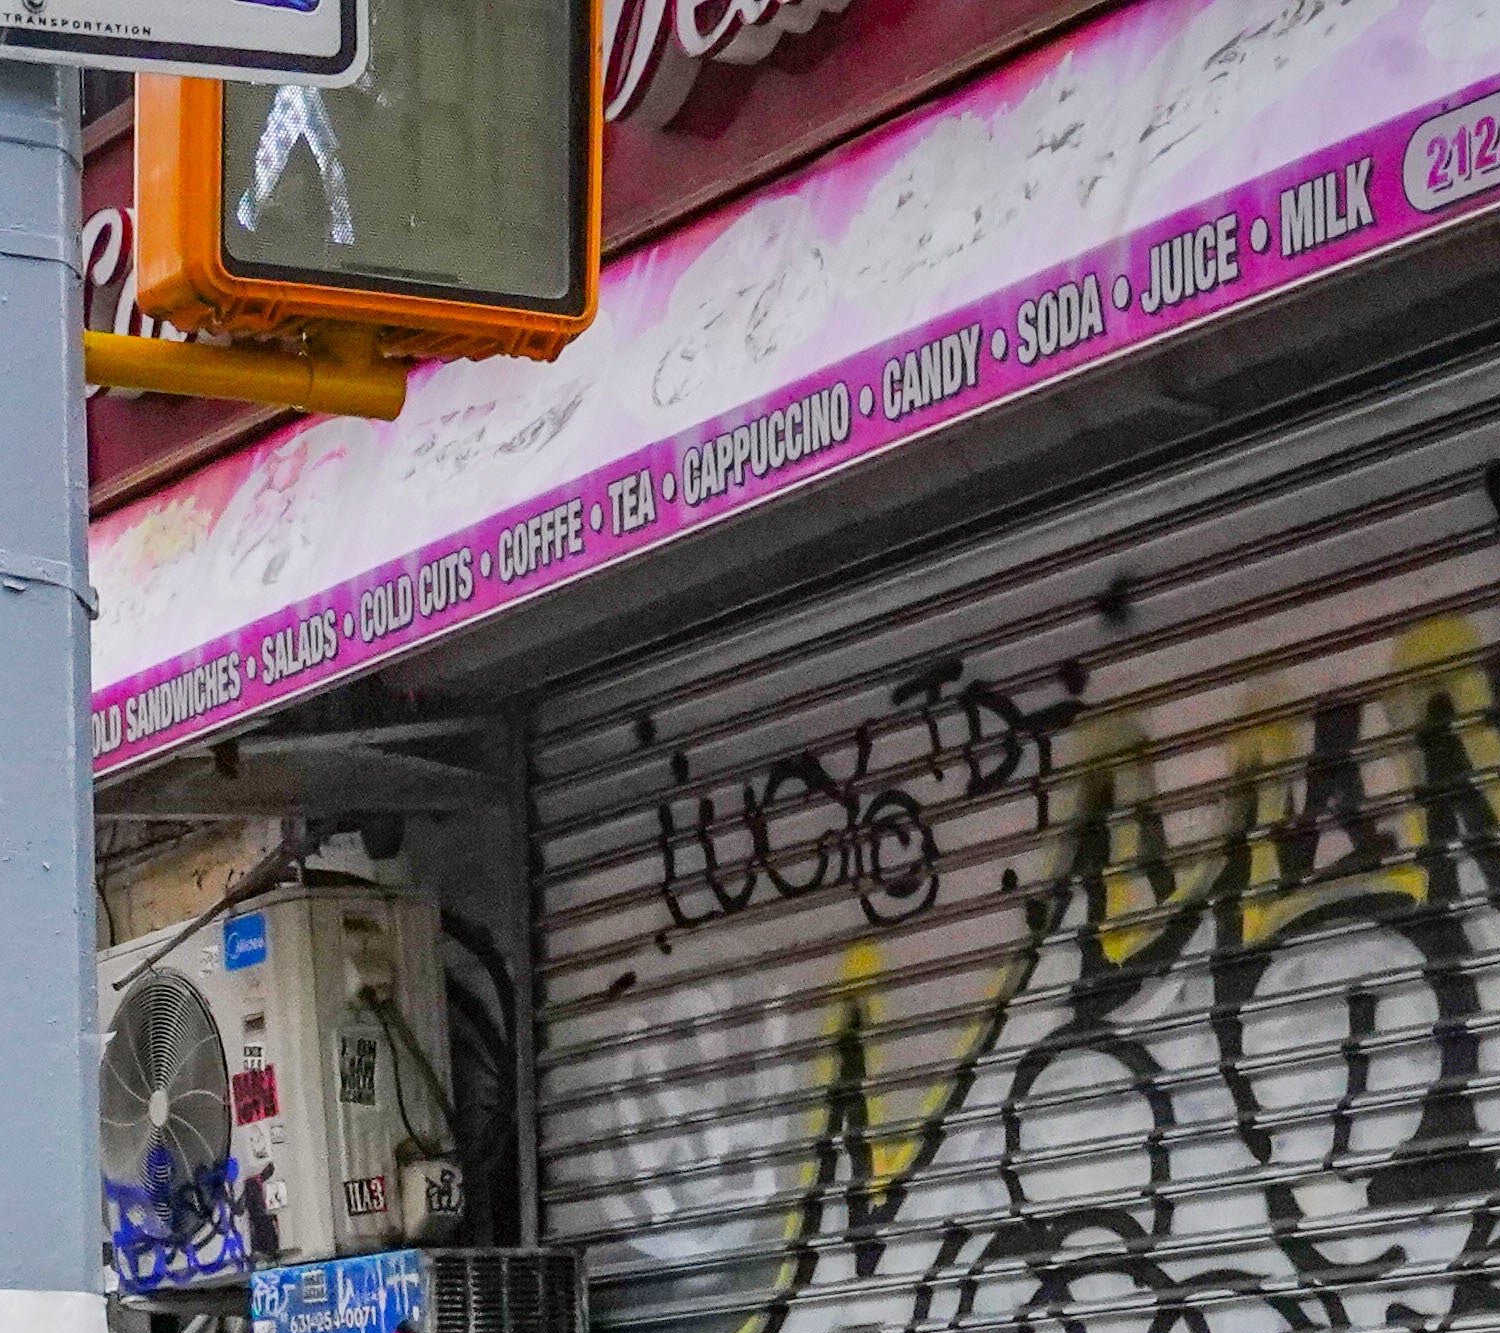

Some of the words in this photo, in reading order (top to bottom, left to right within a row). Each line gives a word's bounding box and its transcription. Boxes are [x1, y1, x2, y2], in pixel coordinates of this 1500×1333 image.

[3, 12, 153, 38] TRANSPORTATION
[90, 702, 122, 755] OLD
[126, 651, 241, 742] SANDWICHES
[261, 608, 339, 685] SALADS
[359, 582, 413, 643] COLD
[418, 547, 475, 618] CUTS
[607, 470, 656, 534] TEA
[682, 381, 851, 506] CAPPUCCINO
[881, 322, 982, 421] CANDY
[1015, 273, 1105, 366] SODA
[1141, 213, 1240, 314] JUICE
[1279, 157, 1374, 257] MILK
